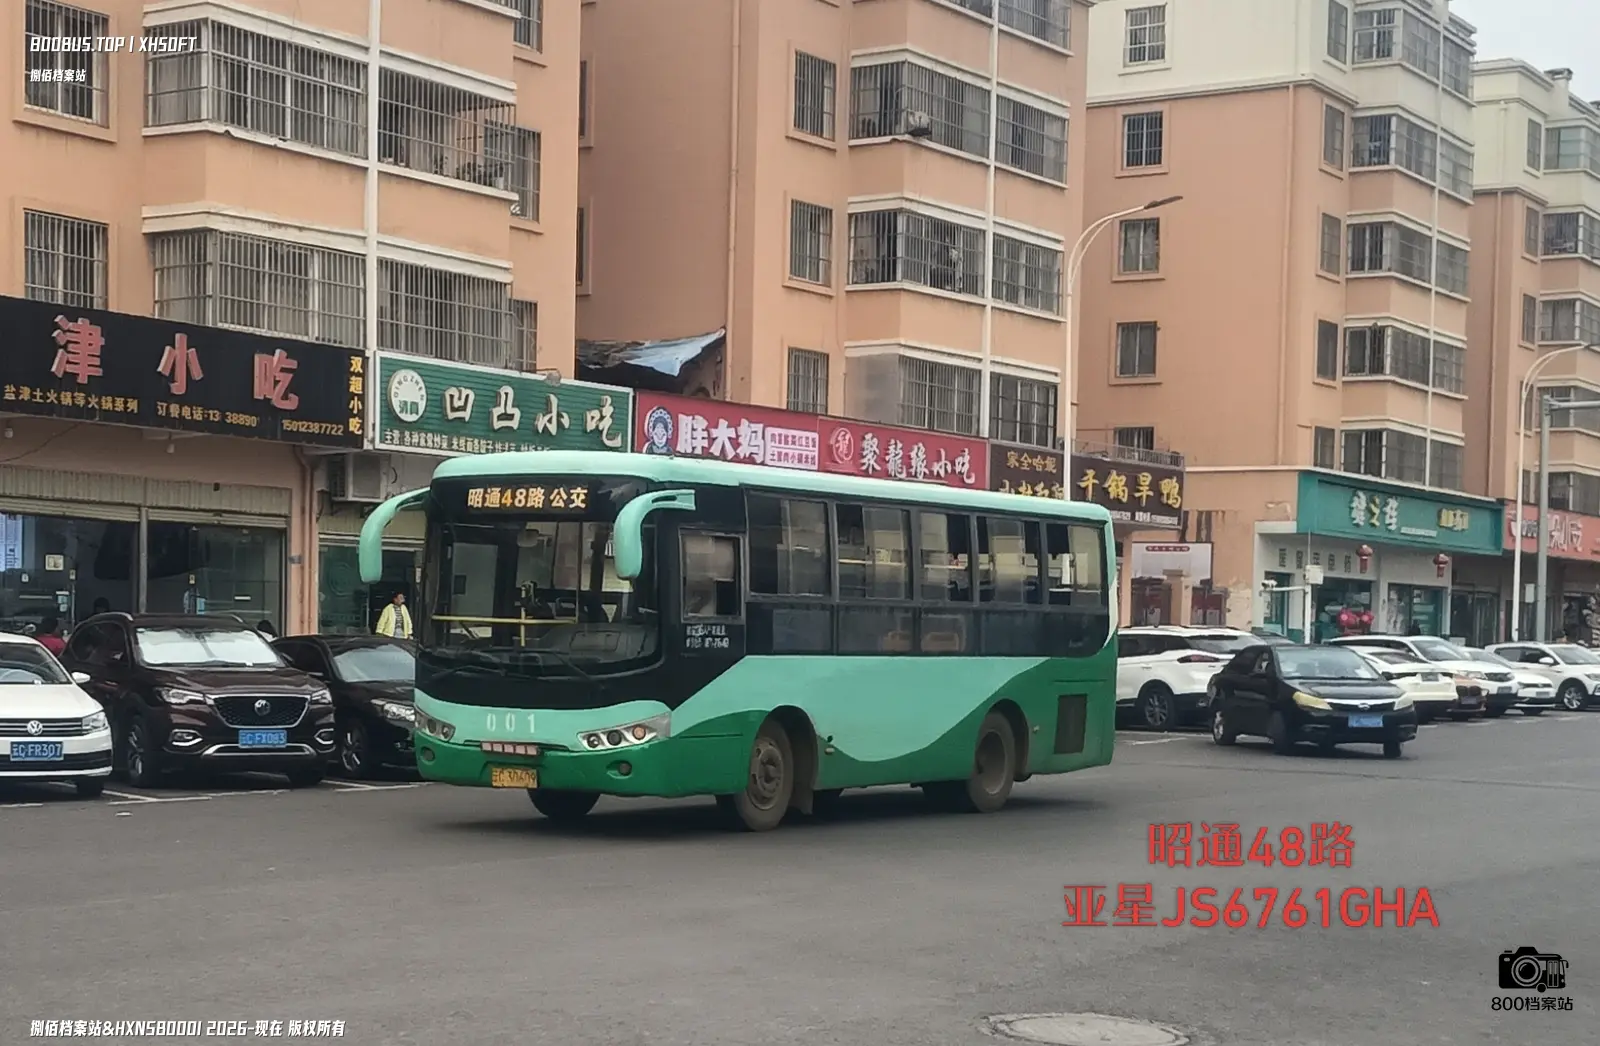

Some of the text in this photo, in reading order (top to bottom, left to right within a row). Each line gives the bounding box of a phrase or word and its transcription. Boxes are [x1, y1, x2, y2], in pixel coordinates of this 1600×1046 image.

[3, 384, 139, 414] 盐津土火锅等火锅系列
[348, 355, 364, 435] 双超小吃
[282, 419, 344, 436] 15012387722
[444, 386, 622, 447] 凹凸小吃
[676, 413, 765, 464] 胖大妈
[467, 487, 588, 509] 昭通48路 公交
[1076, 467, 1183, 510] 干锅旱鸭
[486, 711, 535, 734] 001
